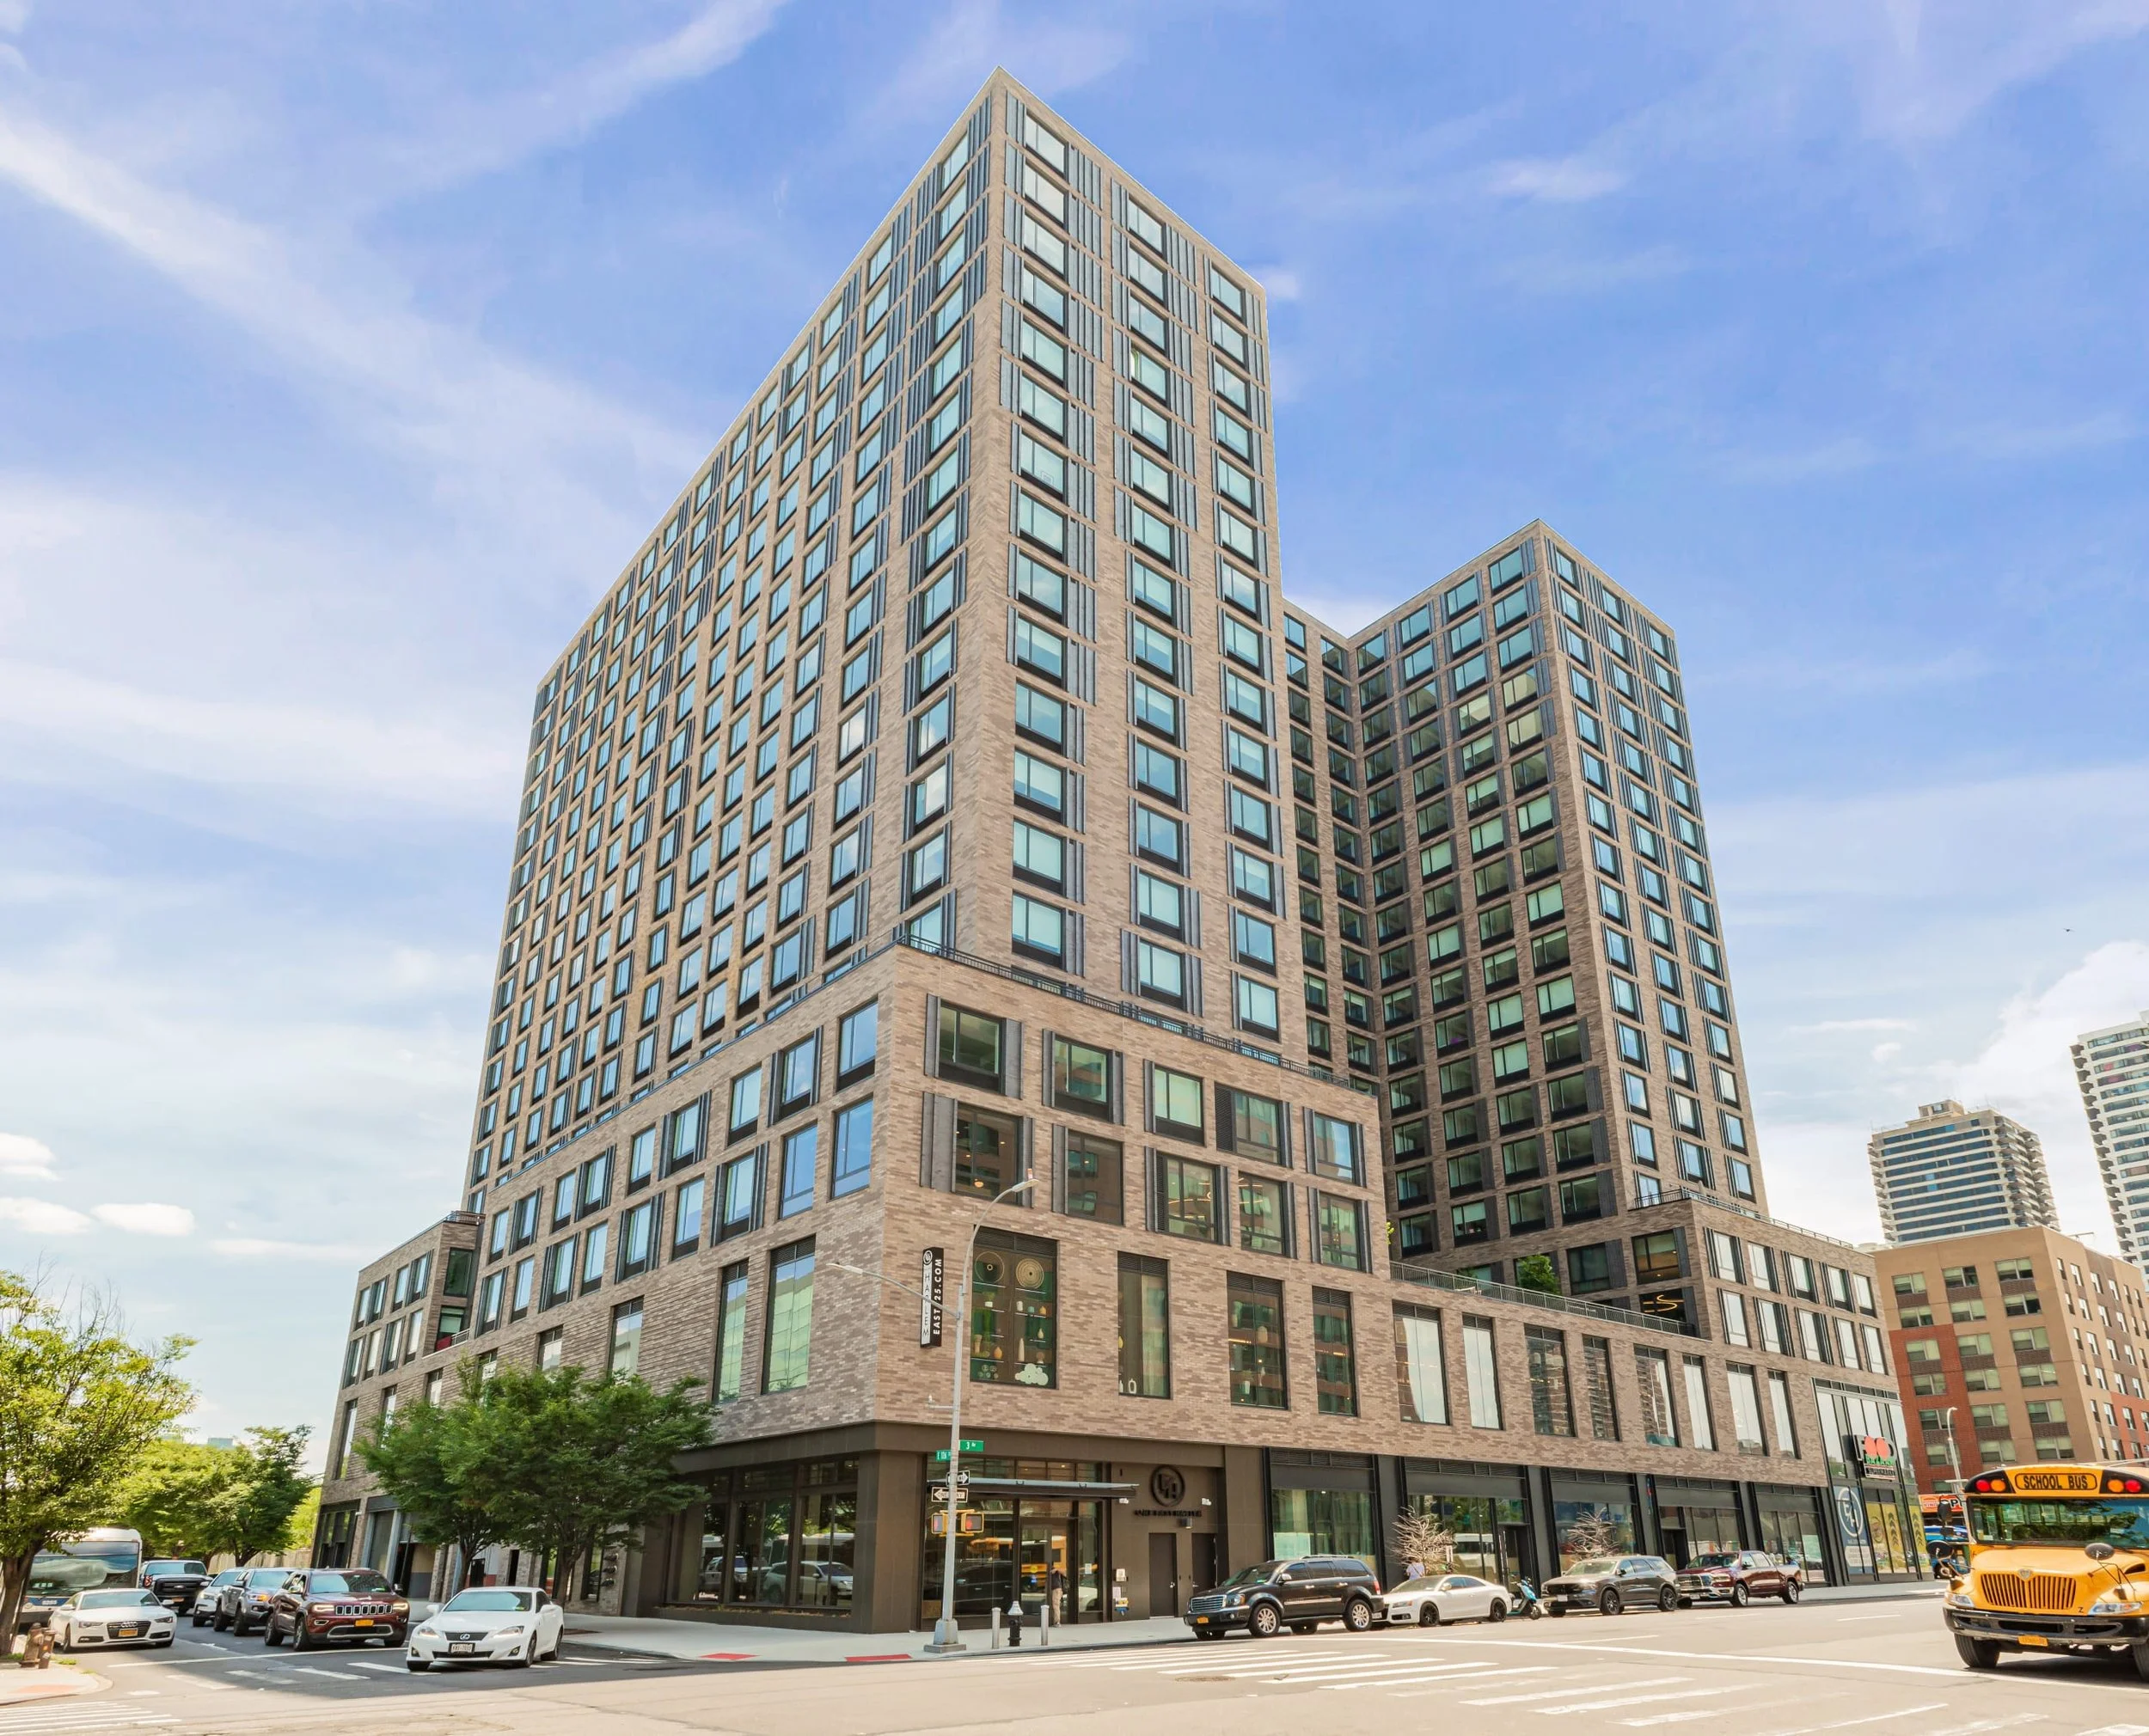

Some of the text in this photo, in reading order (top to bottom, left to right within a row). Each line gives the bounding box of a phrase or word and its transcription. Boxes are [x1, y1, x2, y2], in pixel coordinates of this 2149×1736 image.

[934, 1259, 942, 1335] EAST25.COM
[2023, 1475, 2088, 1490] SCHOOL BUS
